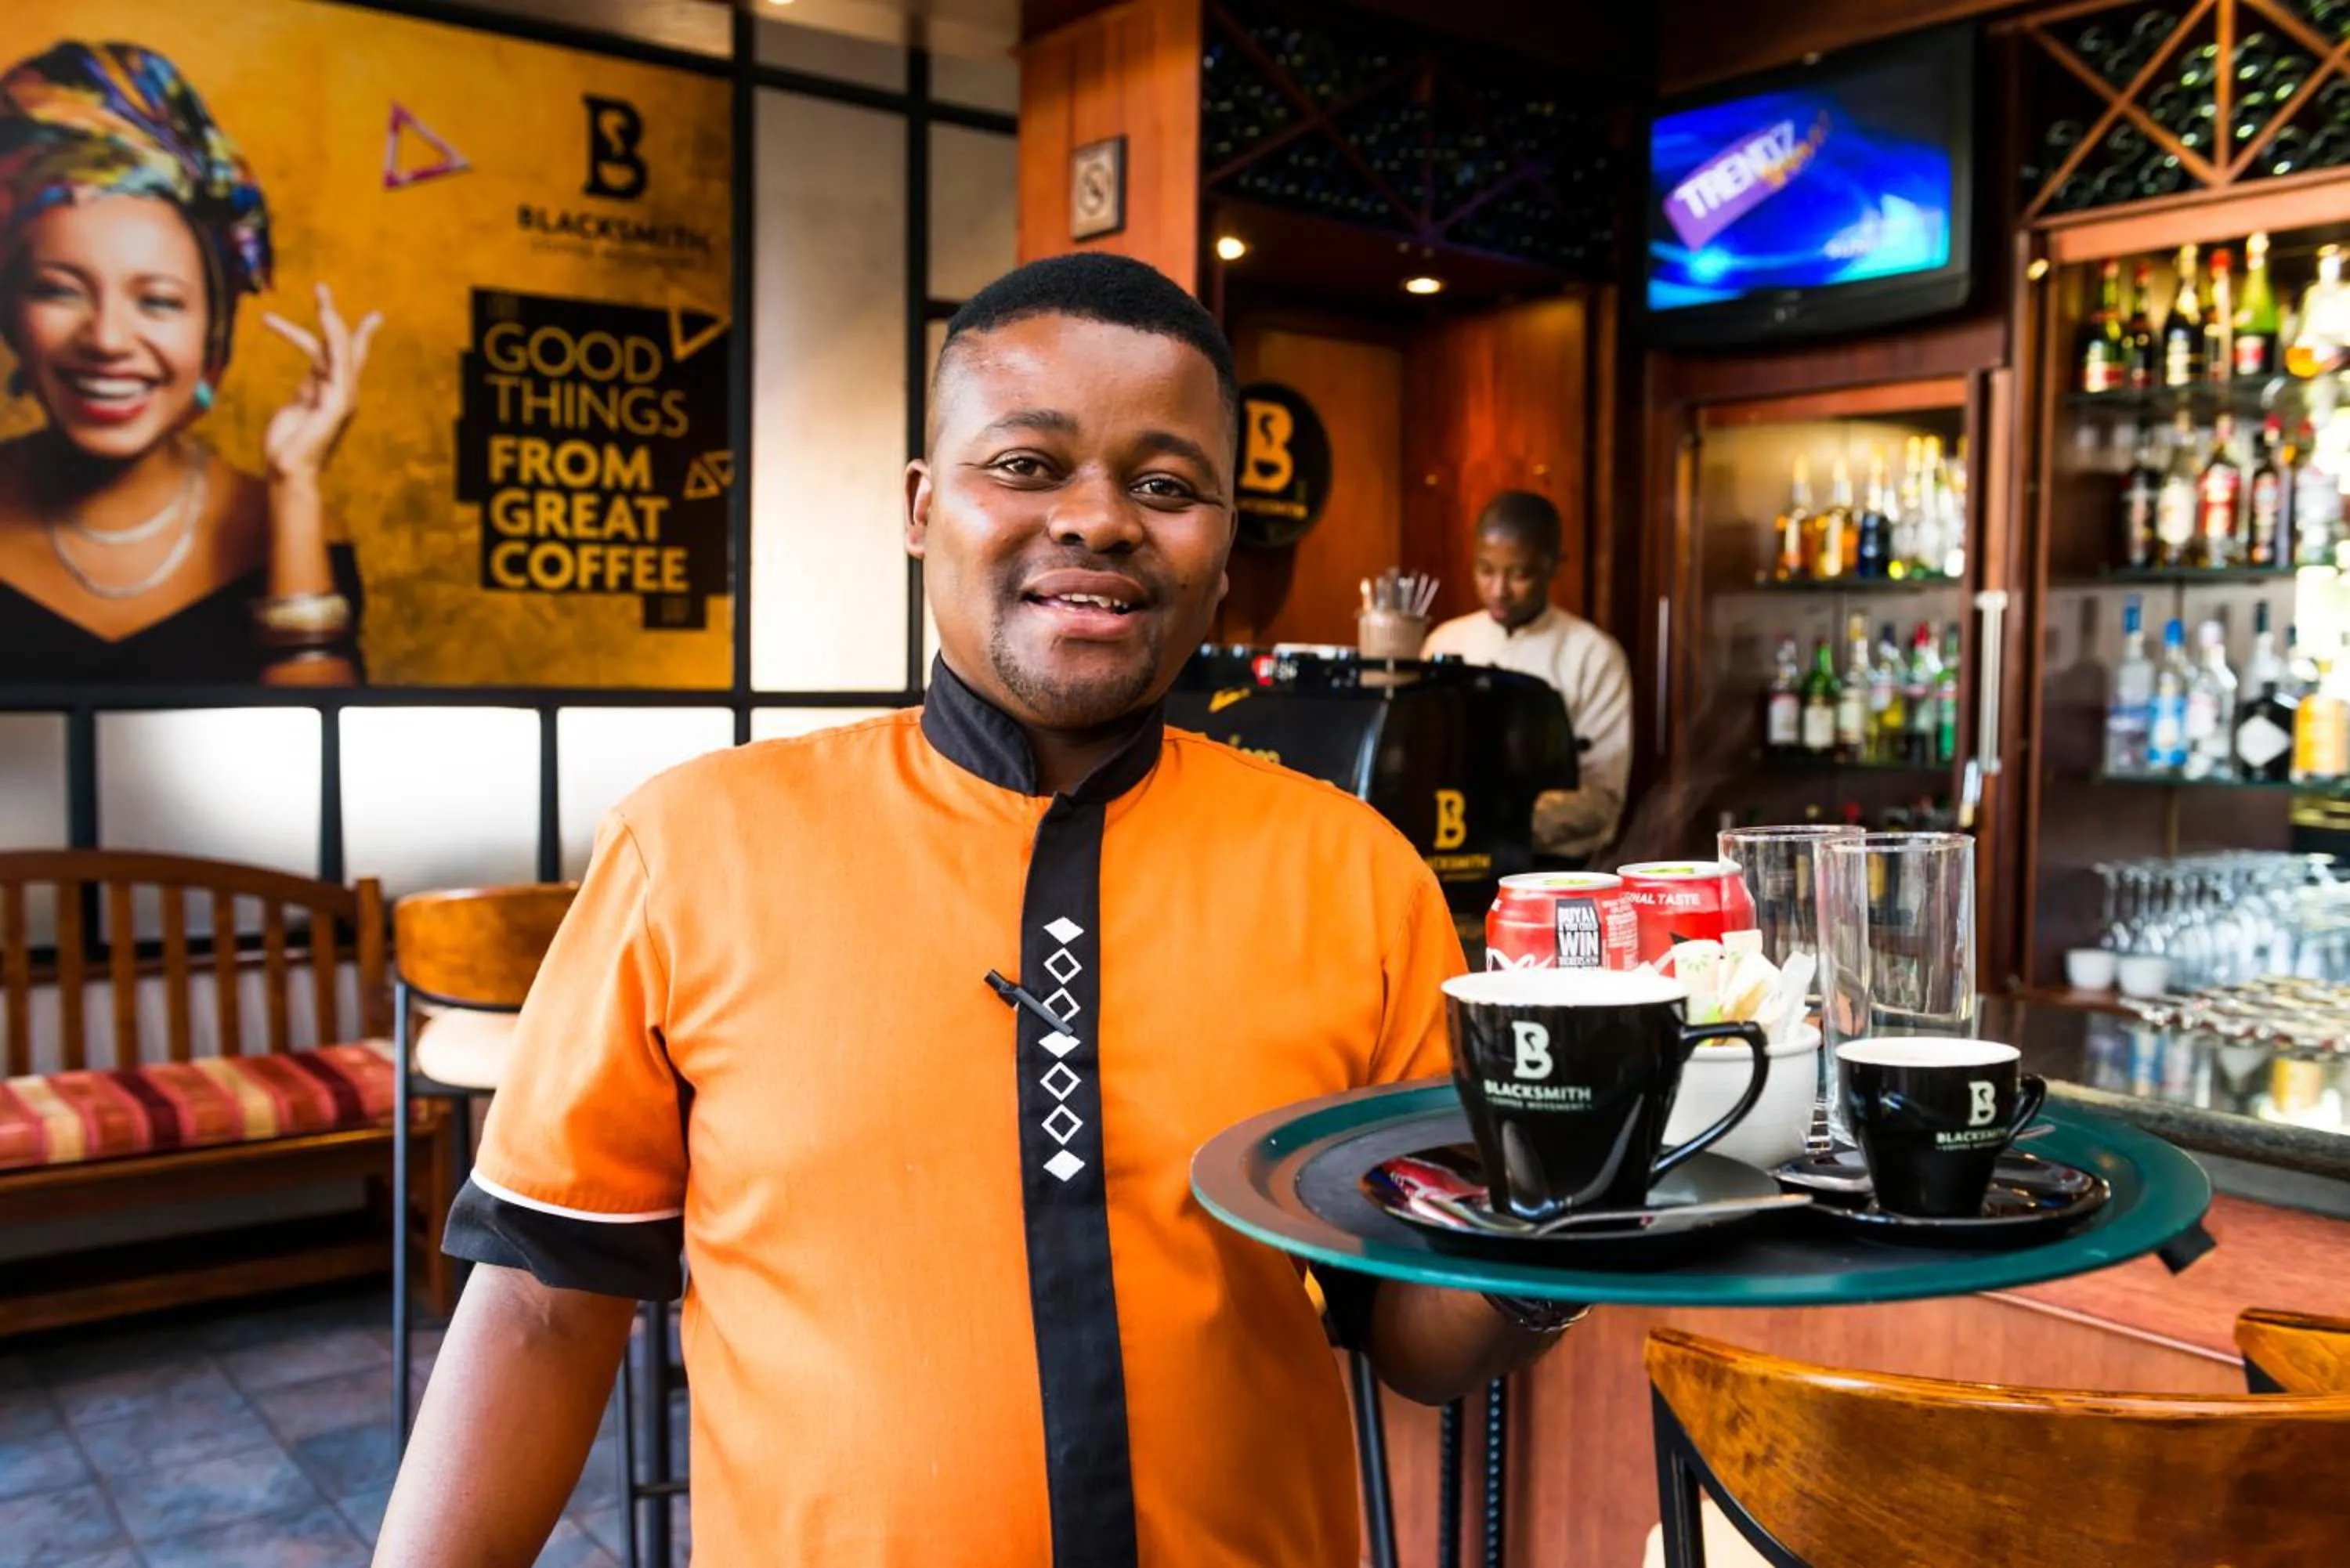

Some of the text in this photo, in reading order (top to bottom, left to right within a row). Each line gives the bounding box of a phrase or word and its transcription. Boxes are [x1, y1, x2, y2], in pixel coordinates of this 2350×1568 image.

[483, 323, 663, 384] GOOD
[484, 374, 689, 438] THINGS
[488, 434, 653, 490] FROM
[490, 487, 670, 542] GREAT
[490, 540, 689, 591] COFFEE
[1658, 893, 1701, 905] TASTE
[1559, 930, 1599, 956] WIN
[1484, 1078, 1592, 1100] BLACKSMITH
